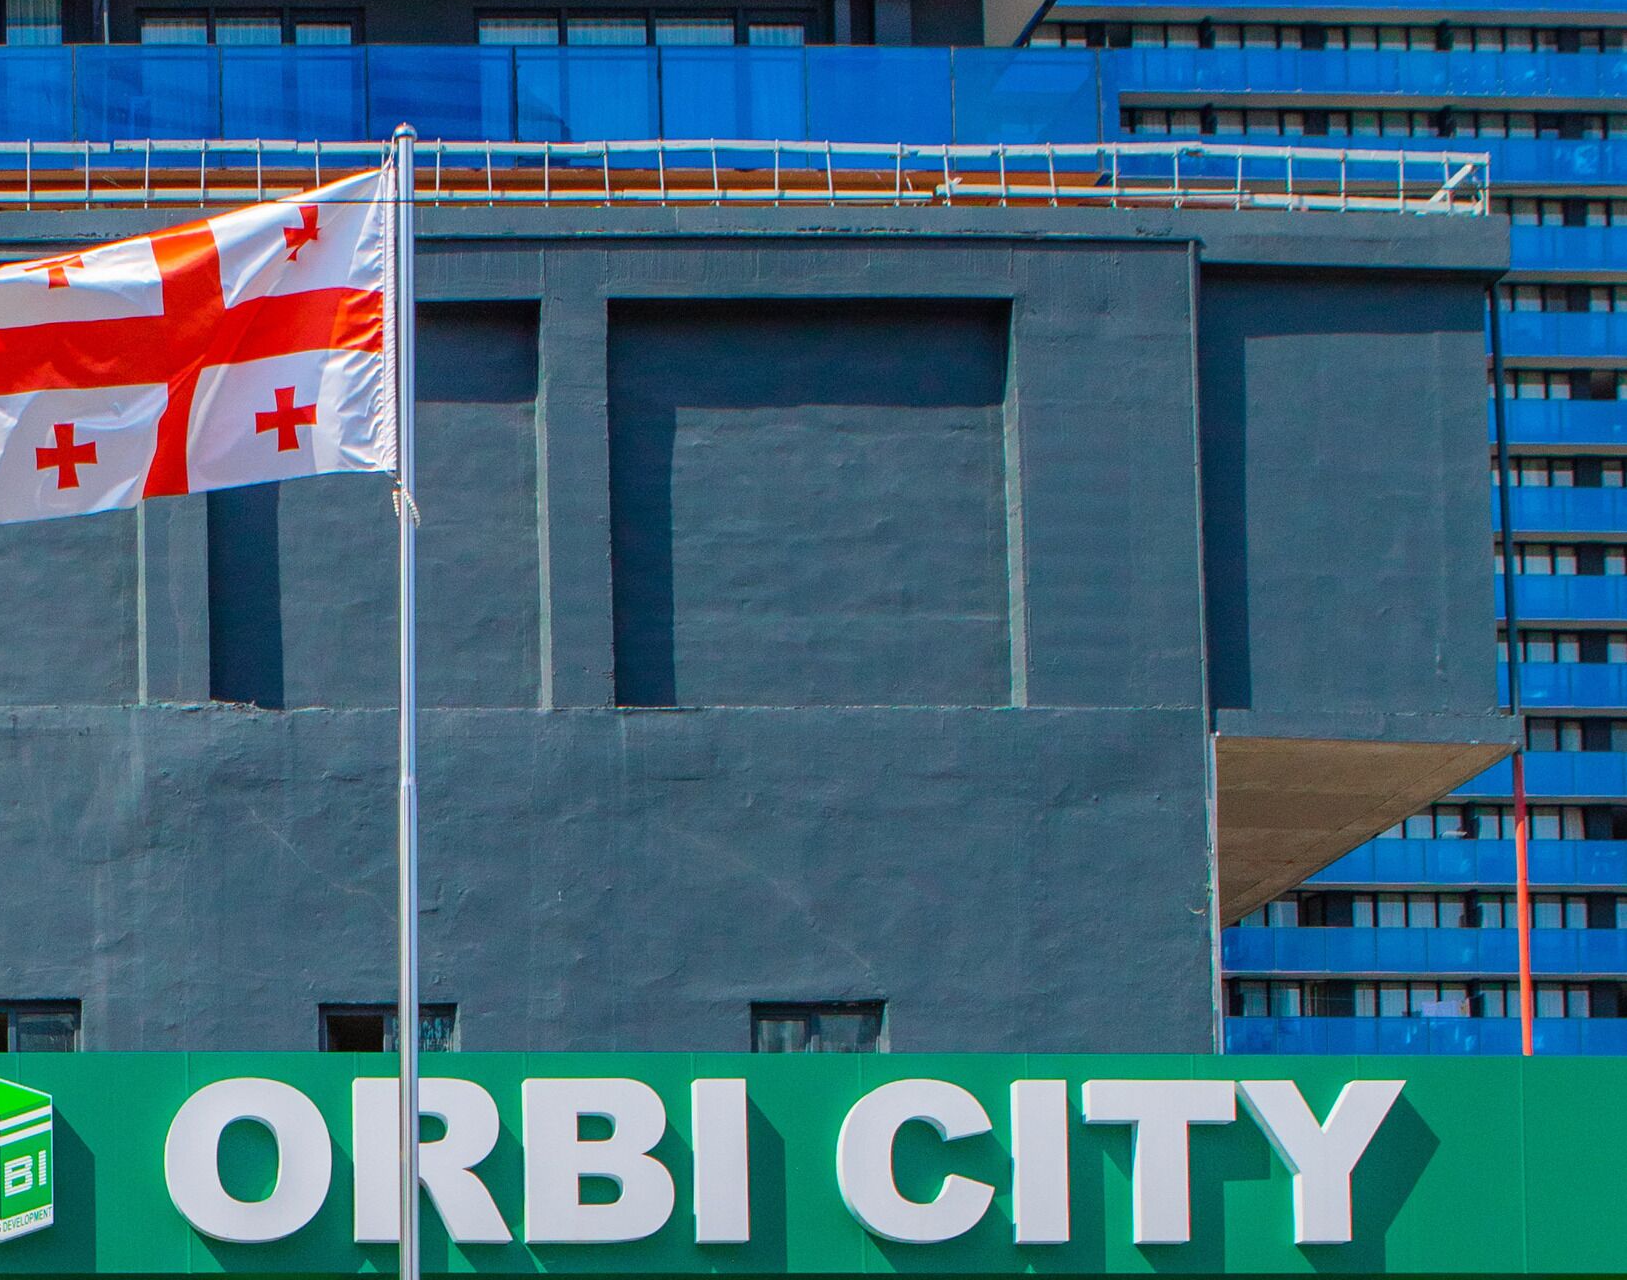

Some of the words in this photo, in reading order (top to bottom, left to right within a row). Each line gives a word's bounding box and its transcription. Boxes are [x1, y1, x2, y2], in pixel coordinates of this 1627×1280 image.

[163, 1076, 750, 1244] ORBI
[835, 1078, 1407, 1245] CITY
[2, 1206, 53, 1233] DEVELOPMENT
